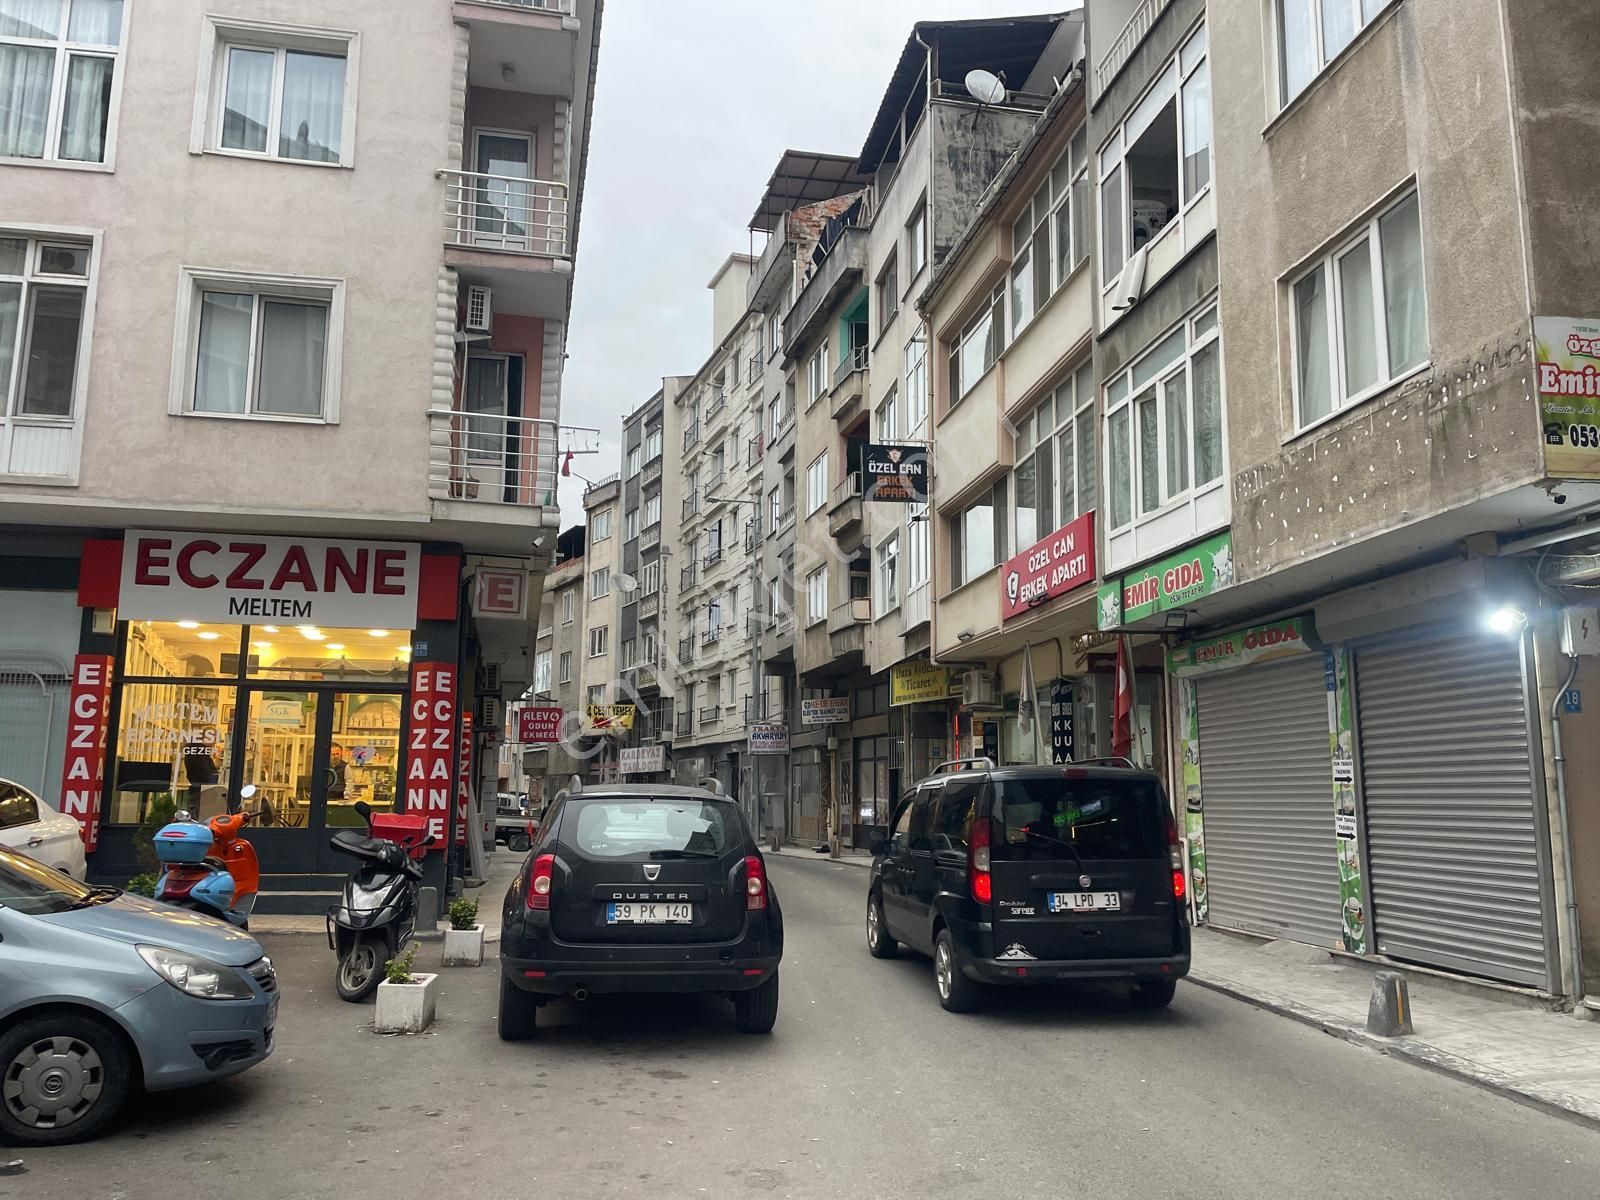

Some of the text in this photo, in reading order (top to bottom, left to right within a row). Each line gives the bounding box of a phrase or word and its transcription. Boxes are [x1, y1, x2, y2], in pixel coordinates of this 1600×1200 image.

[1570, 425, 1600, 448] 053
[869, 460, 922, 474] ÖZEL CAN
[876, 475, 913, 487] ERKEK
[1028, 532, 1074, 573] ÖZEL CAN
[135, 538, 407, 595] ECZANE
[1020, 553, 1086, 603] ERKEK APARTI
[1123, 558, 1204, 611] EMİR GIDA
[487, 576, 514, 608] E
[228, 597, 313, 618] MELTEM
[1196, 640, 1234, 662] EMİR
[1565, 692, 1579, 704] 18
[134, 703, 218, 723] MELTEM
[523, 711, 550, 721] ALEV
[528, 722, 554, 730] ODUN
[752, 732, 787, 741] AKVARYUM
[64, 664, 101, 830] ECZAN
[408, 671, 430, 811] ECZAN
[90, 665, 113, 844] ECZANE
[428, 671, 452, 840] ECZANE
[1055, 894, 1068, 907] 34
[1104, 893, 1118, 906] 33
[615, 905, 631, 918] 59
[640, 905, 656, 918] PK
[666, 905, 689, 918] 140
